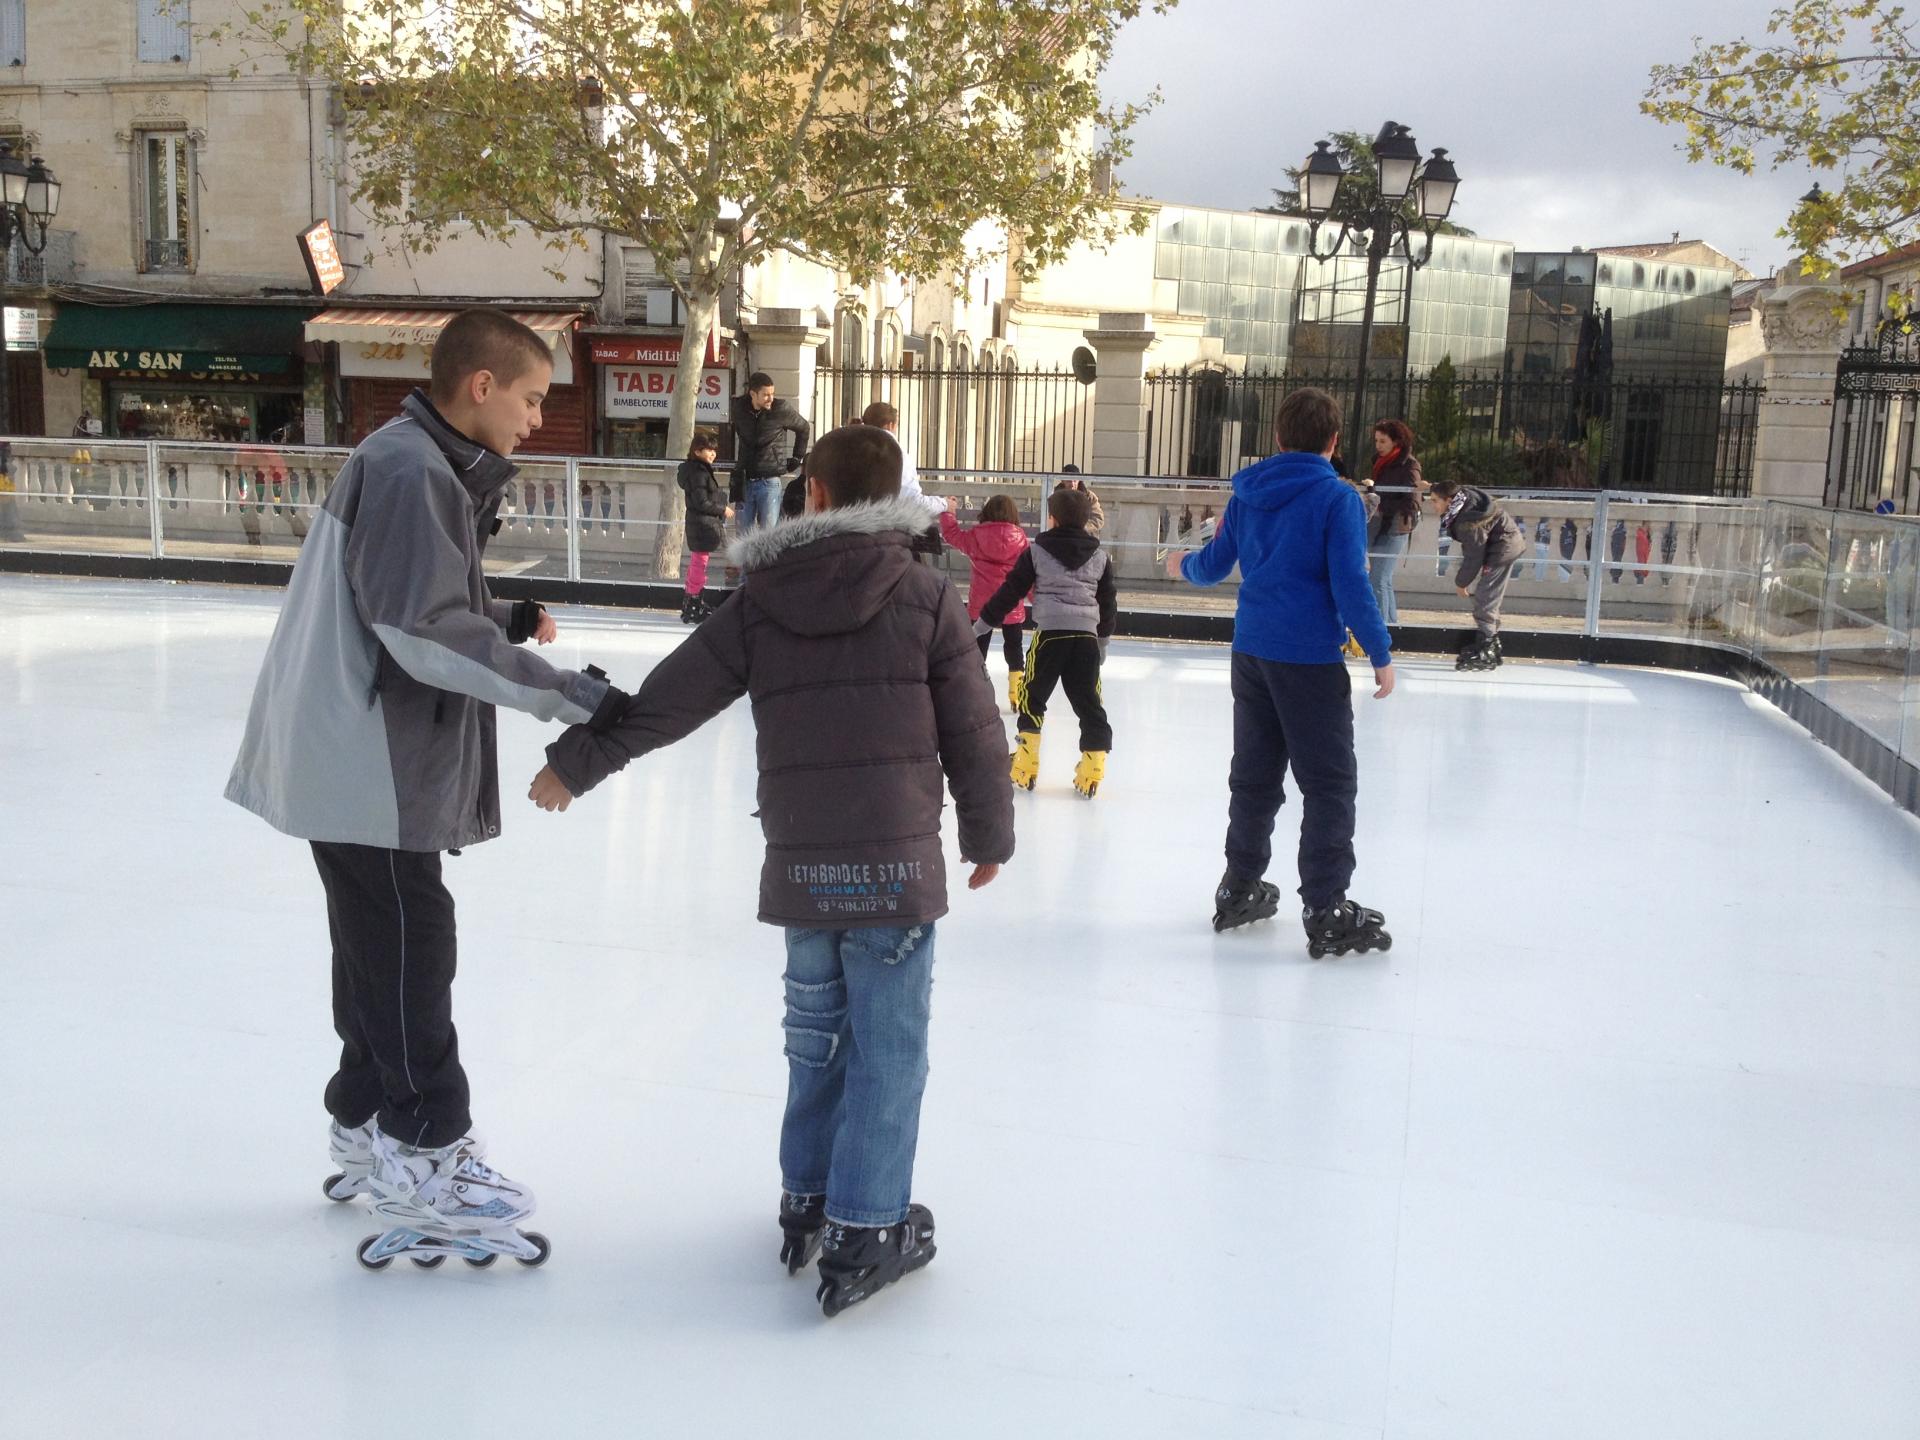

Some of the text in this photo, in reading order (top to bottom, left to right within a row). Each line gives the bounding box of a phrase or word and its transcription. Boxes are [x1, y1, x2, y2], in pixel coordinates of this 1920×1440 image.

[139, 352, 183, 370] SAN
[594, 350, 619, 358] TABAC
[636, 349, 663, 361] Midi
[613, 398, 668, 408] BIMBELOTERIE
[787, 861, 922, 884] LETHBRIDGE STATE
[809, 882, 878, 896] HIGHWAY
